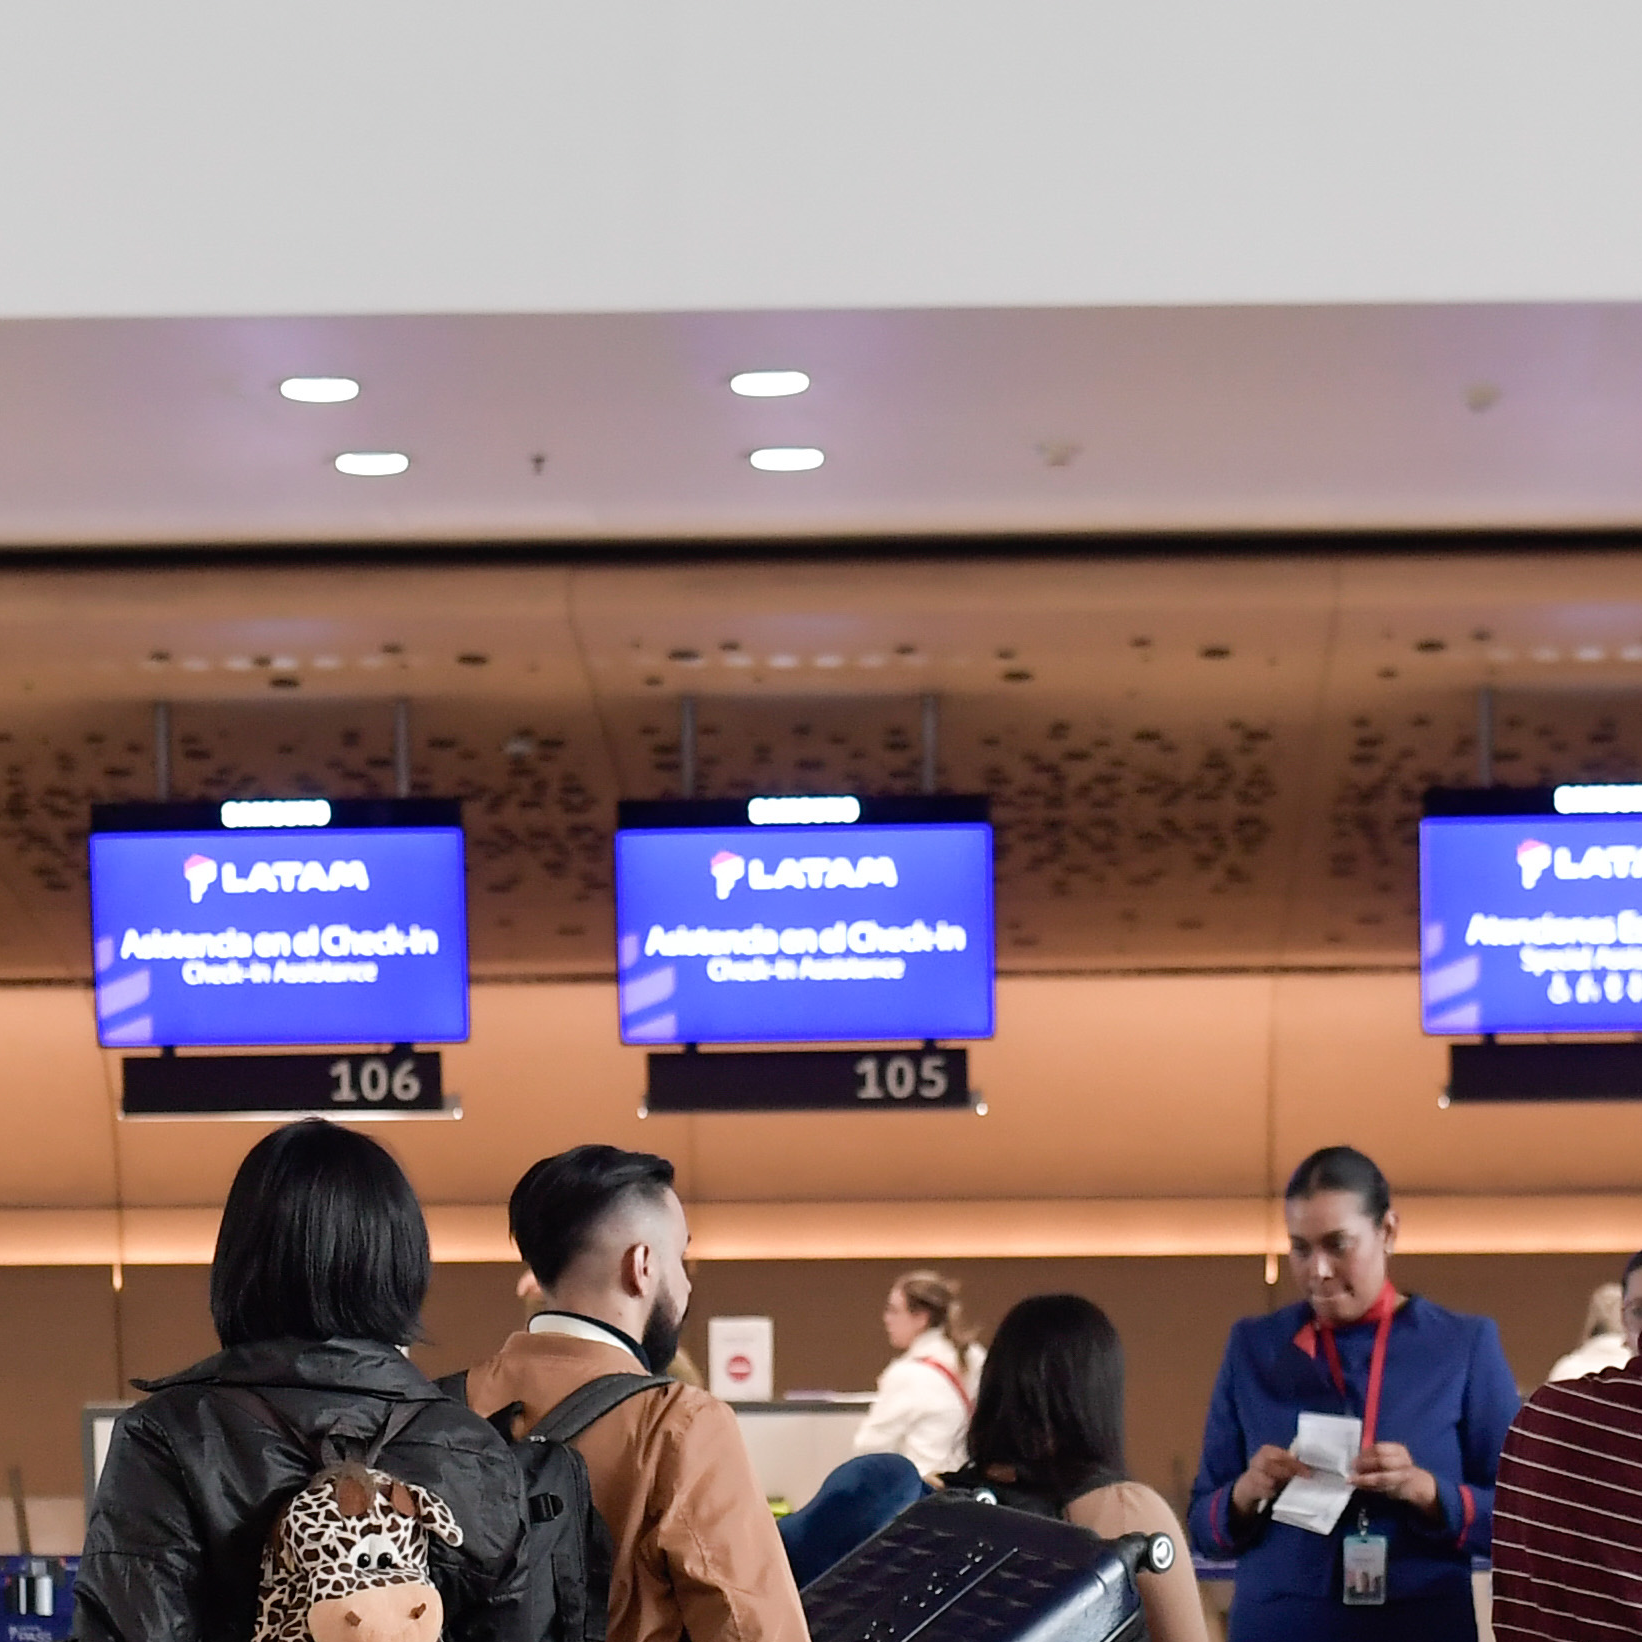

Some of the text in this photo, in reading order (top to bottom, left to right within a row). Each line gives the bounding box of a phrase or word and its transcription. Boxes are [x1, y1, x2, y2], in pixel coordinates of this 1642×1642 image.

[221, 860, 370, 893] LATAM
[748, 857, 899, 890] LATAM
[329, 1060, 421, 1102] 106
[854, 1056, 950, 1100] 105
